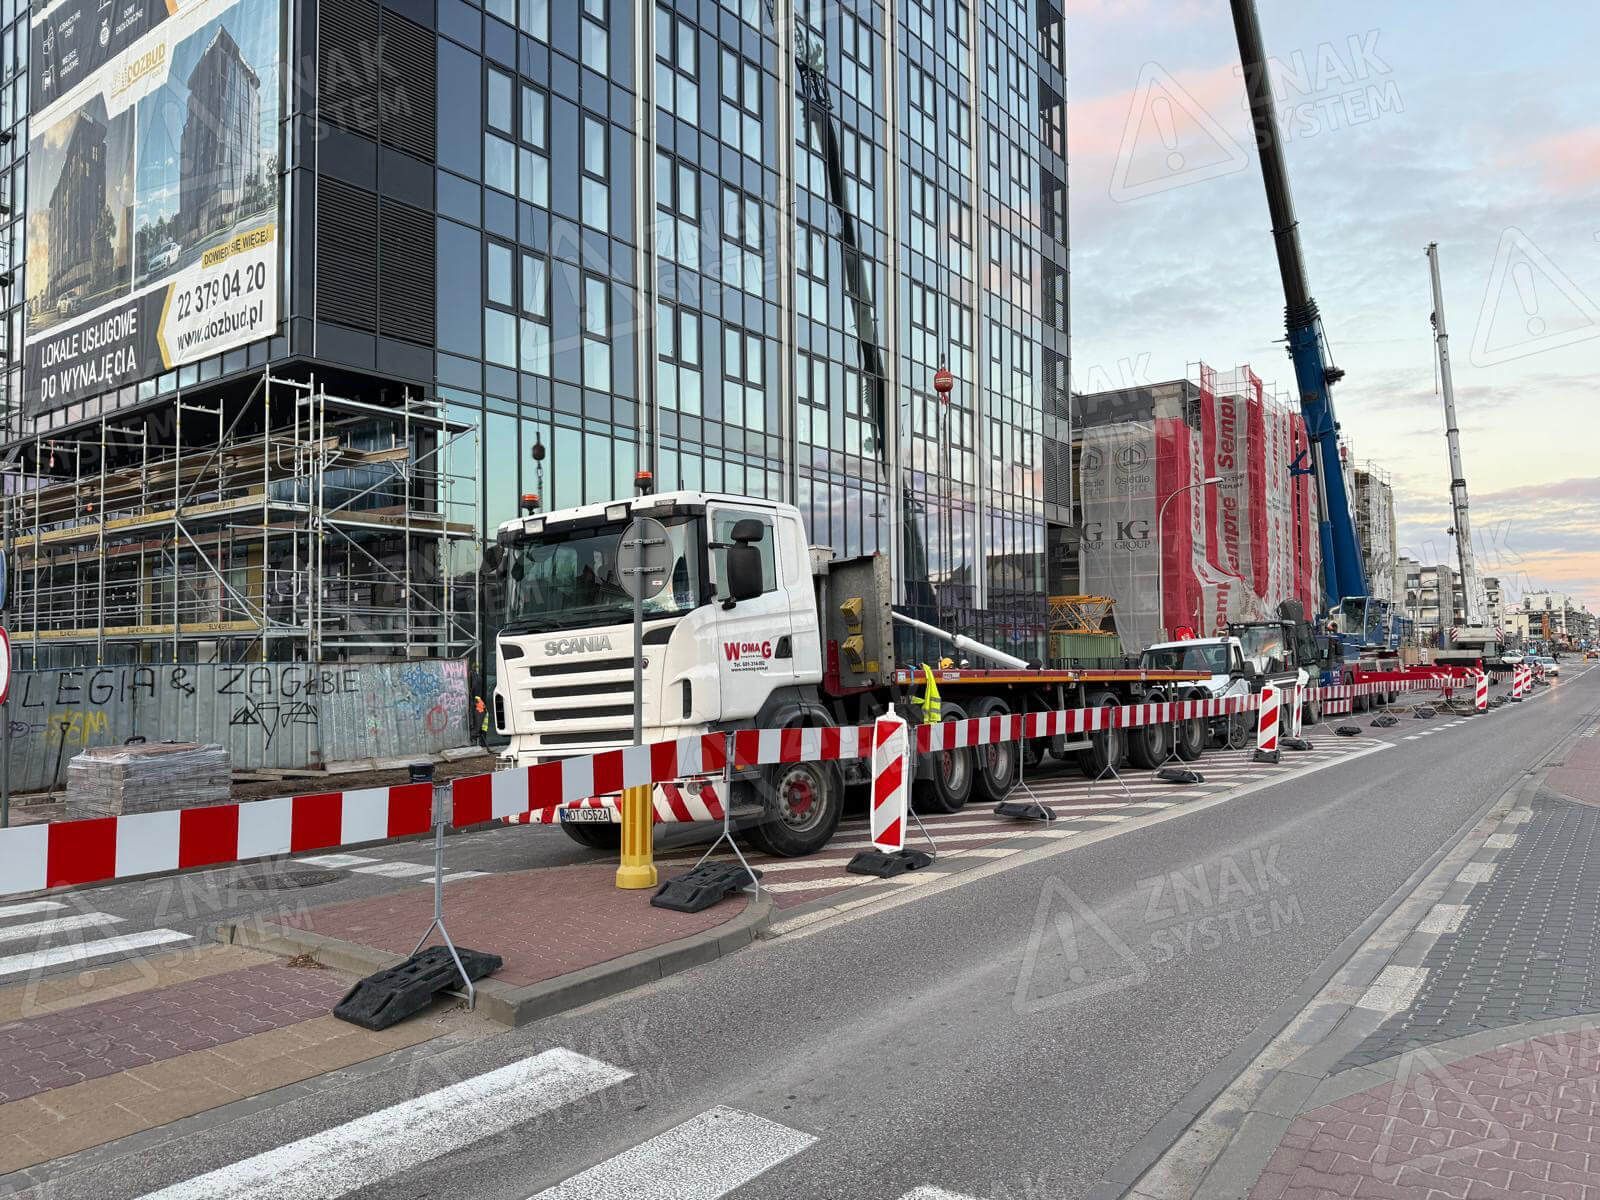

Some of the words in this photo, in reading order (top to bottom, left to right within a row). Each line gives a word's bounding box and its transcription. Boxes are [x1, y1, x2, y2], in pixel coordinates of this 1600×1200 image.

[127, 43, 165, 82] DOZBUD
[177, 290, 191, 322] 22
[195, 278, 219, 313] 379
[222, 269, 240, 301] 04
[246, 261, 265, 293] 20
[41, 333, 79, 369] LOKALE
[81, 307, 137, 354] USŁUGOWE
[177, 299, 263, 351] www.dozbud.pl
[41, 374, 56, 402] DO
[60, 345, 137, 394] WYNAJĘCIA
[1114, 540, 1151, 552] GROUP
[1116, 520, 1150, 541] KG
[1223, 496, 1240, 571] empre
[544, 634, 613, 657] SCANIA
[724, 640, 772, 661] WOMAG
[22, 668, 155, 708] LEGIA
[170, 668, 195, 698] &
